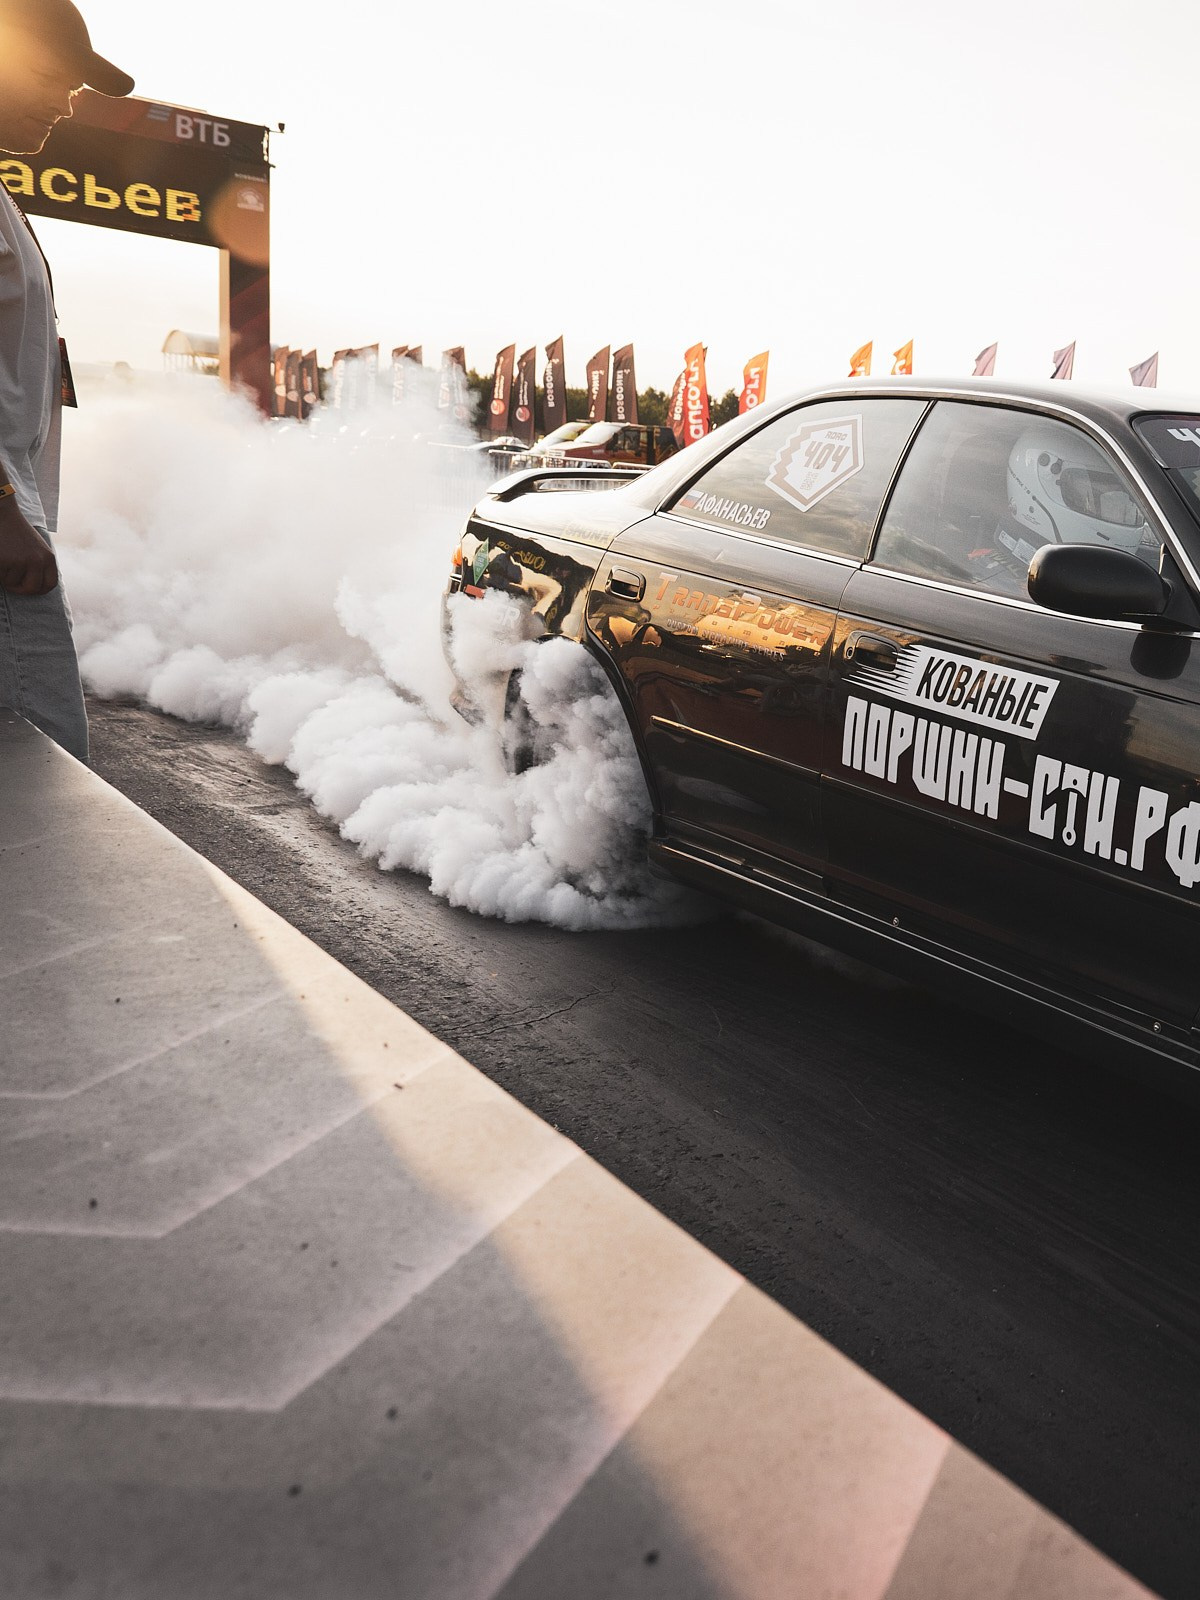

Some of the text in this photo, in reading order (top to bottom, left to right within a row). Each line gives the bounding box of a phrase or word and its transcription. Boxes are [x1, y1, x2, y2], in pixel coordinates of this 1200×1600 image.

[176, 114, 231, 147] ВТБ
[803, 441, 850, 473] 404
[695, 492, 771, 530] АФАНАСЬЕВ
[752, 643, 786, 662] SERIES
[915, 656, 1044, 730] КОВАНЫЕ
